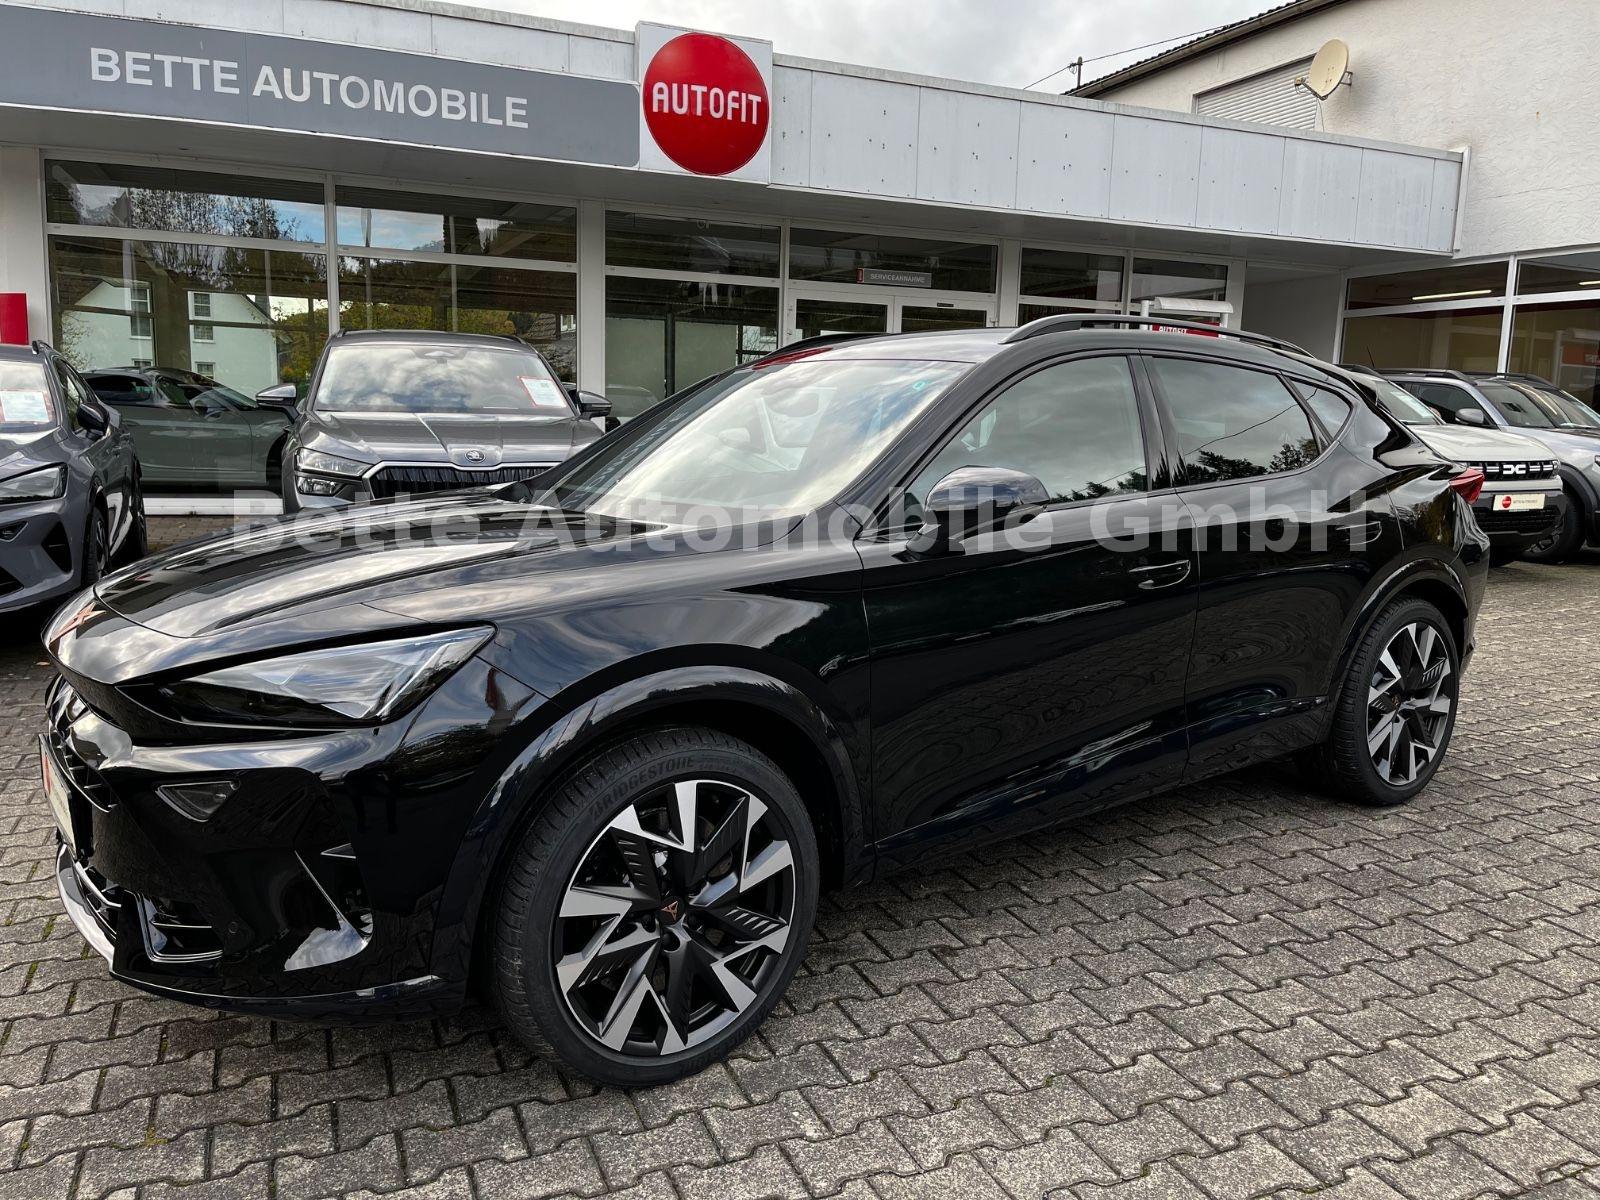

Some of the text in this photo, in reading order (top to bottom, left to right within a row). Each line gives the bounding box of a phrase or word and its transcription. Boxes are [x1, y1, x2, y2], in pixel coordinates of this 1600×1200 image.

[90, 47, 529, 129] BETTE AUTOMOBILE
[652, 82, 762, 125] AUTOFIT
[870, 273, 926, 284] SERVICEANNAHME
